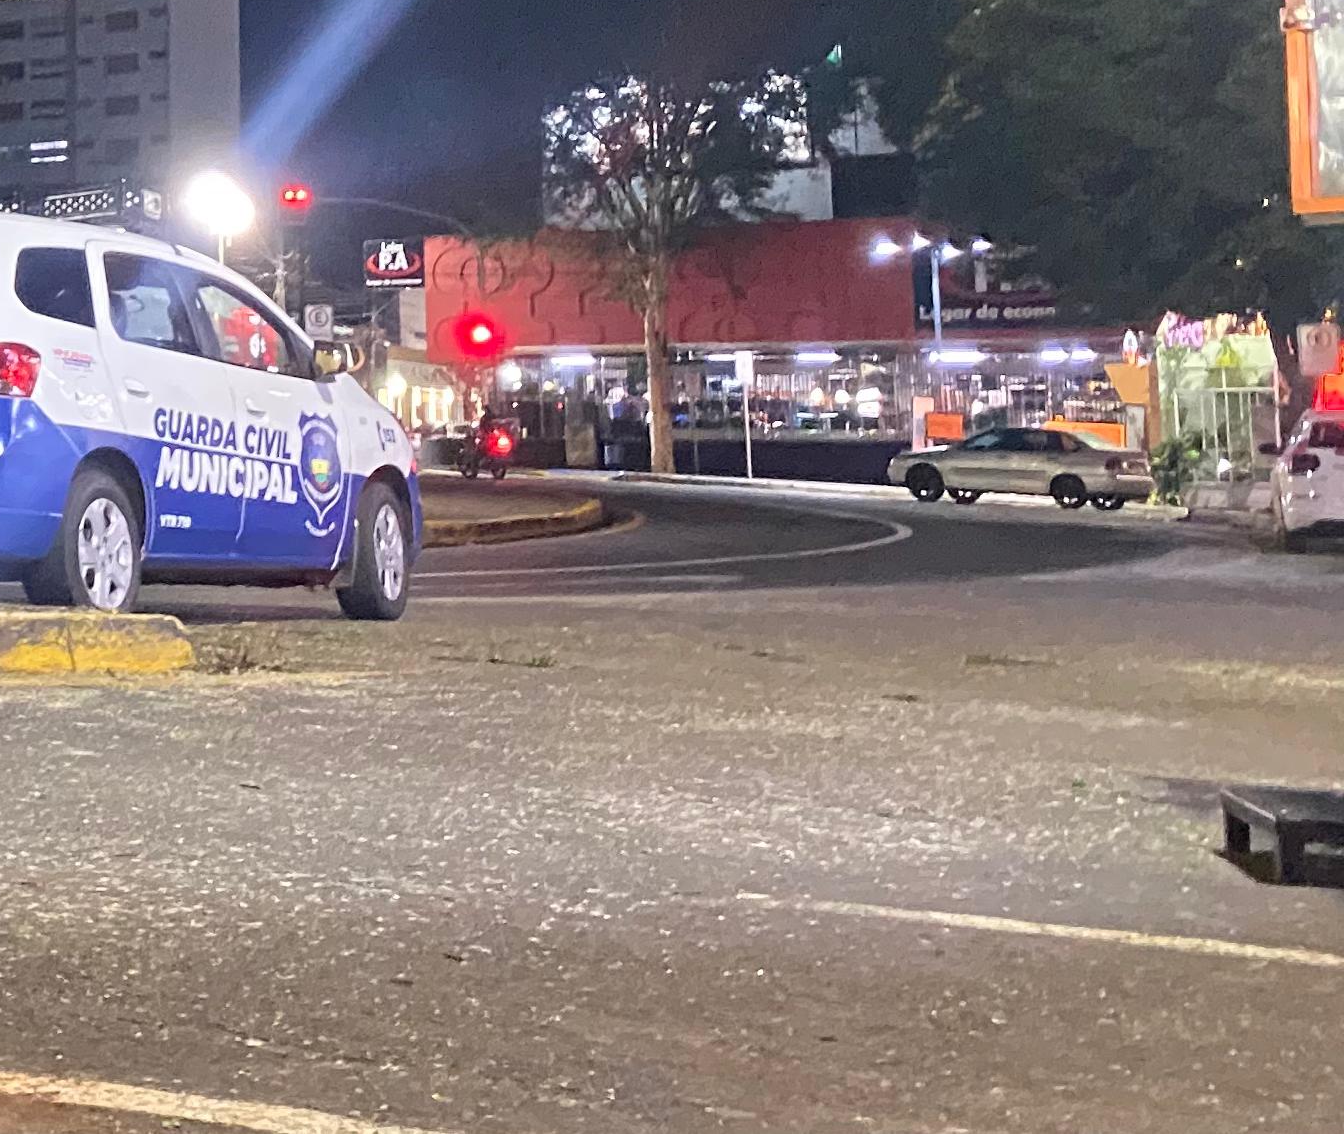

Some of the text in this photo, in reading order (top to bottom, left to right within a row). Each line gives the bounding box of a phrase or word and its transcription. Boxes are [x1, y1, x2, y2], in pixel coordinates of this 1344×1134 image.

[919, 303, 972, 322] Lgar
[154, 407, 237, 451] GUARDA
[244, 424, 291, 460] CIVIL
[155, 446, 298, 505] MUNICIPAL
